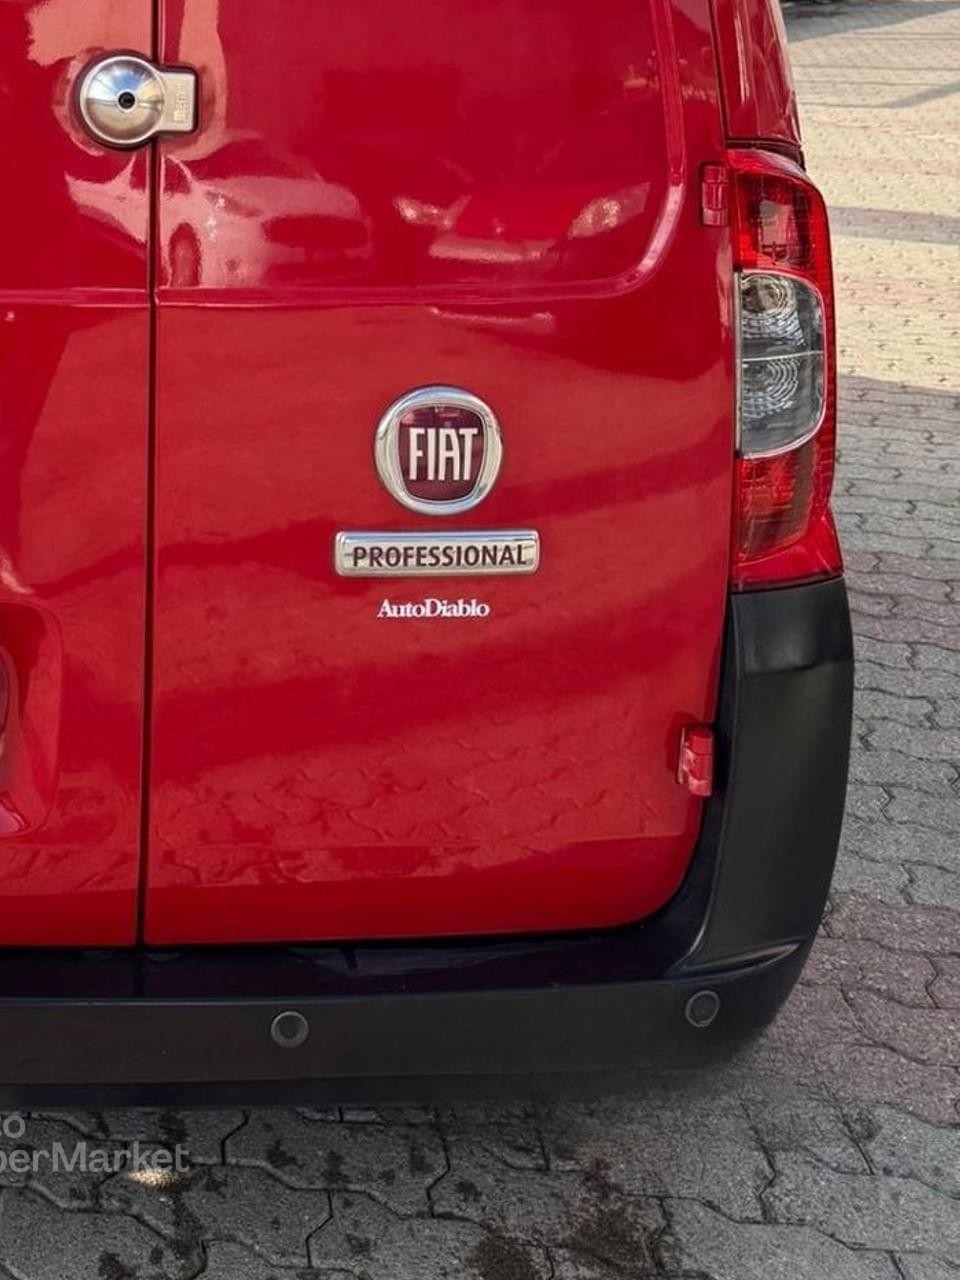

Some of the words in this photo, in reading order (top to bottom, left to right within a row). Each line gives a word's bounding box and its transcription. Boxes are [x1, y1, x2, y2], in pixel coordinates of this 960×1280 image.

[408, 427, 479, 481] FIAT
[352, 543, 528, 568] PROFESSIONAL
[376, 598, 491, 618] AutoDiablo
